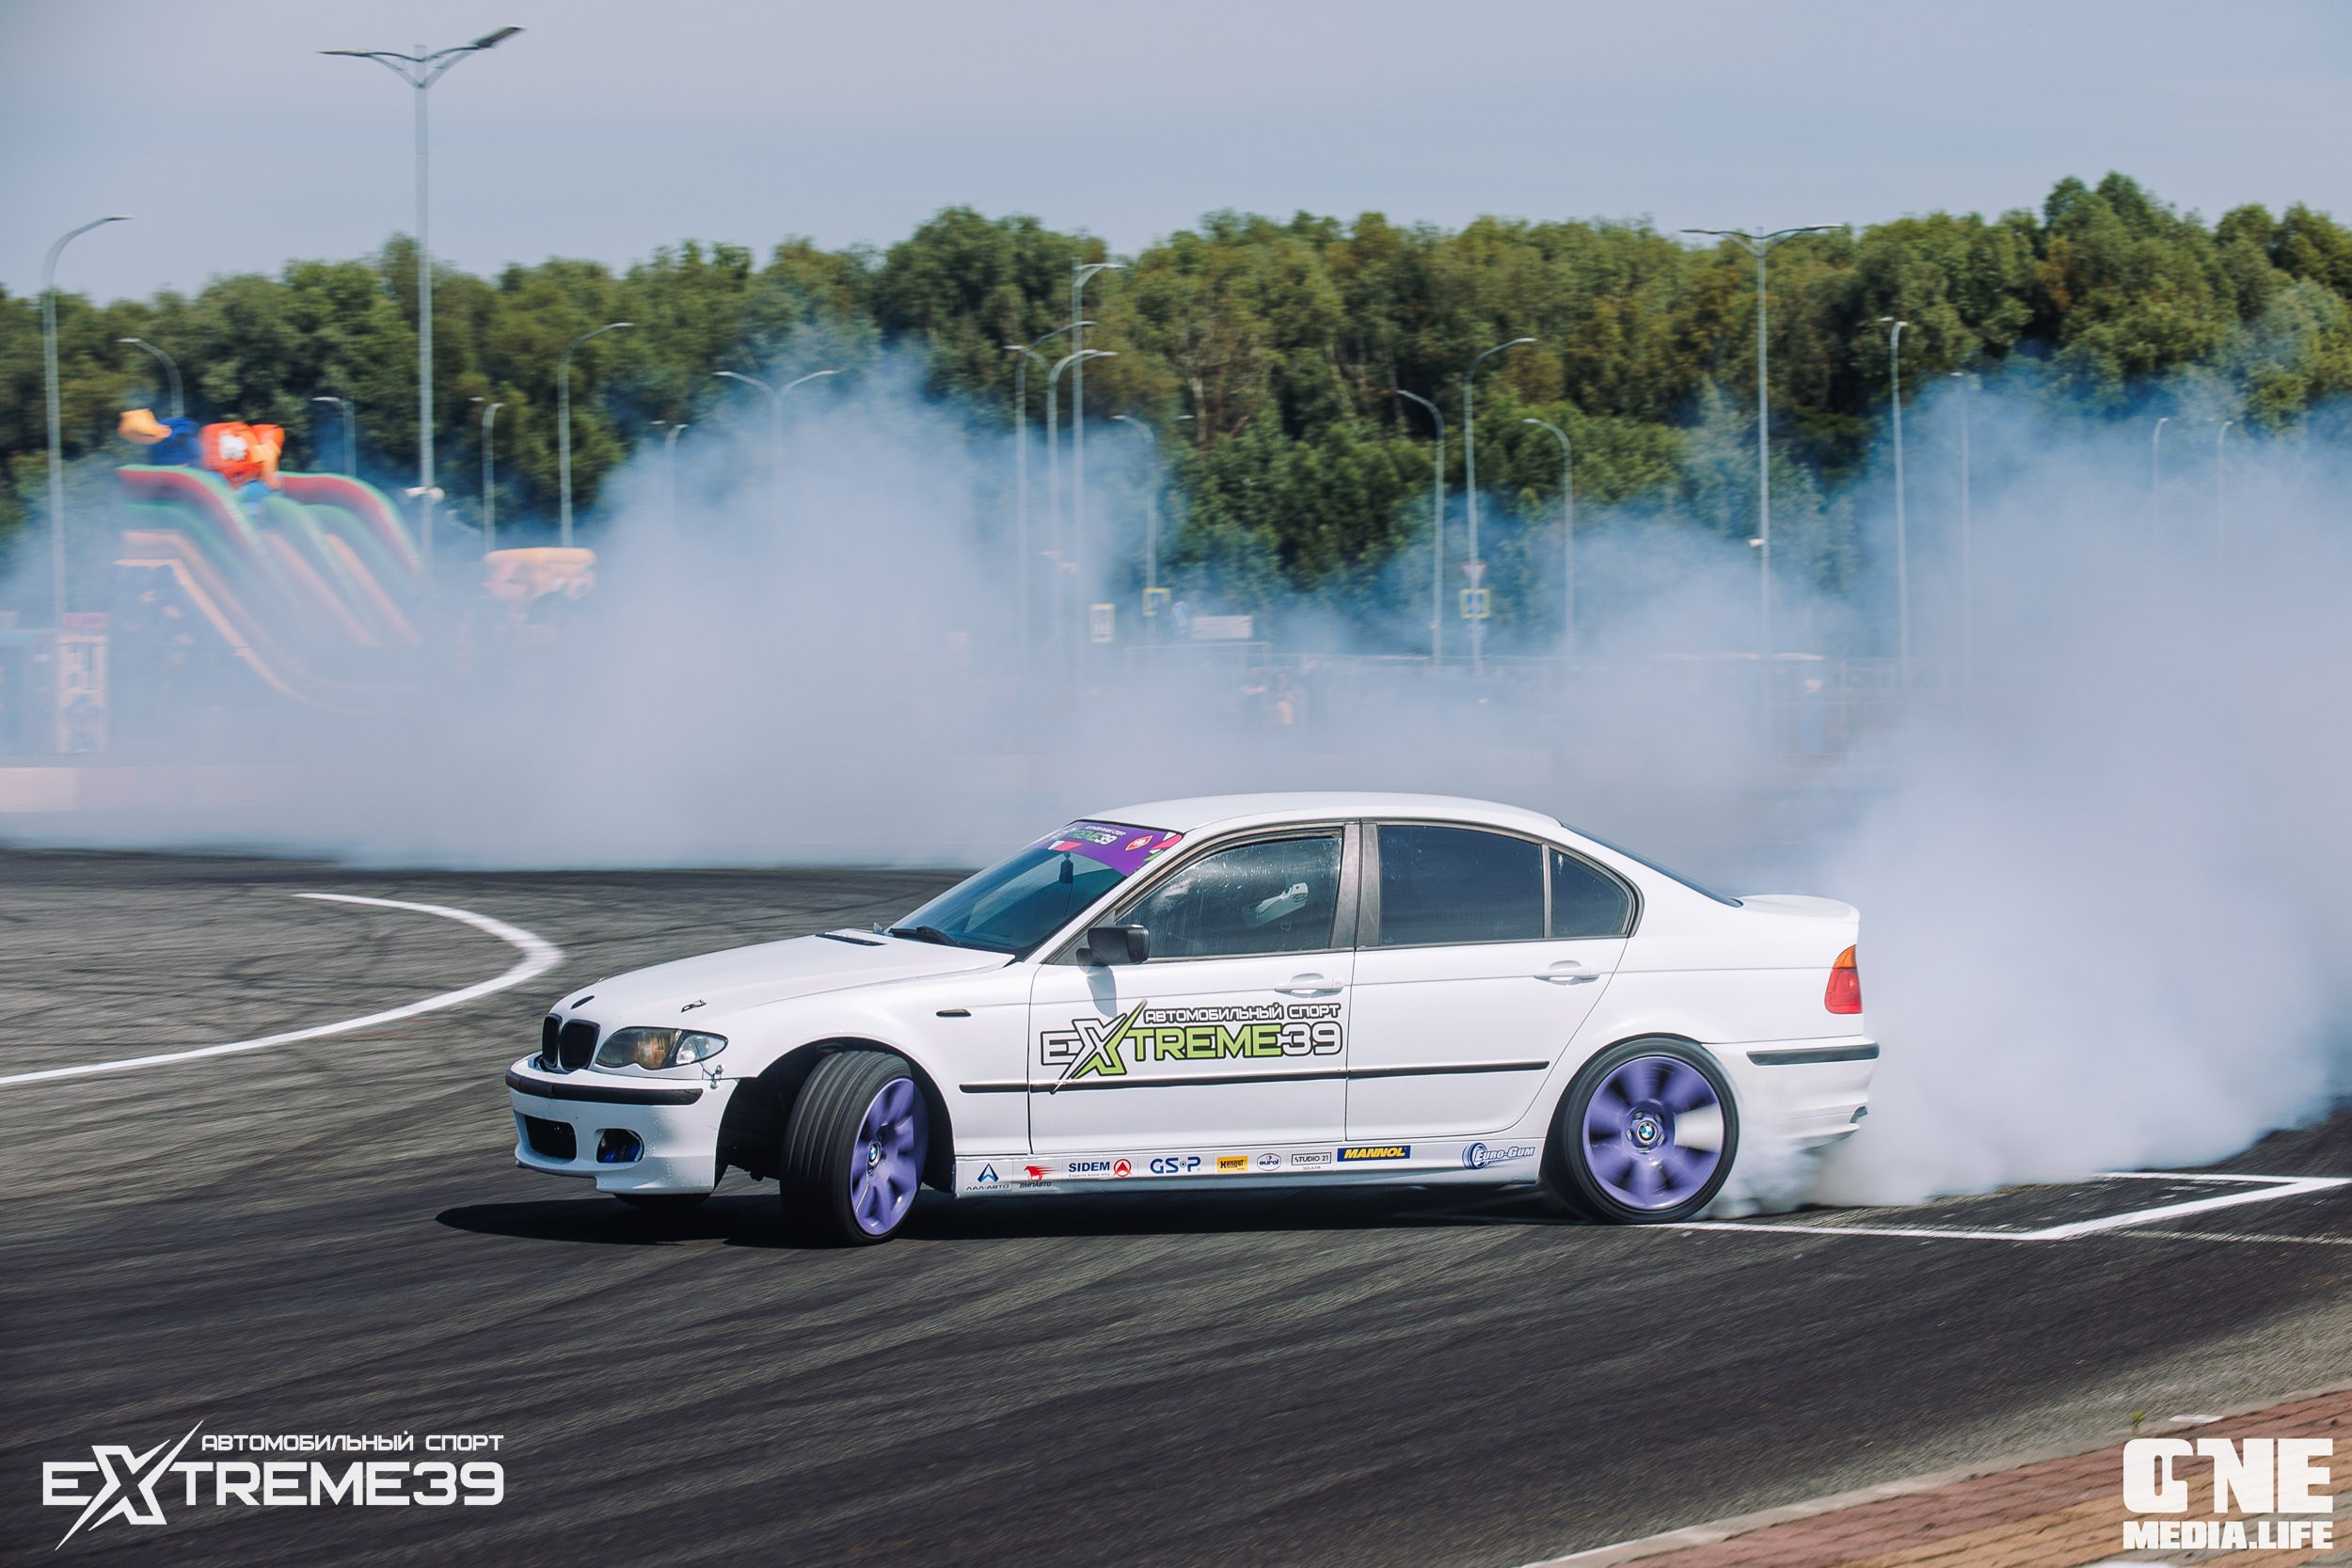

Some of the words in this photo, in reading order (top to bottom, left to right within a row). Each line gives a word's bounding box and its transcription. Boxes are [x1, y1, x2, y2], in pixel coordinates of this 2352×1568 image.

[1144, 1004, 1282, 1023] АВТОМОБИЛЬНЫЙ
[1288, 1003, 1341, 1019] СПОРТ
[1041, 1000, 1343, 1094] EXTREME39
[1343, 1146, 1406, 1160] MANNOL
[1068, 1162, 1110, 1172] SIDEM
